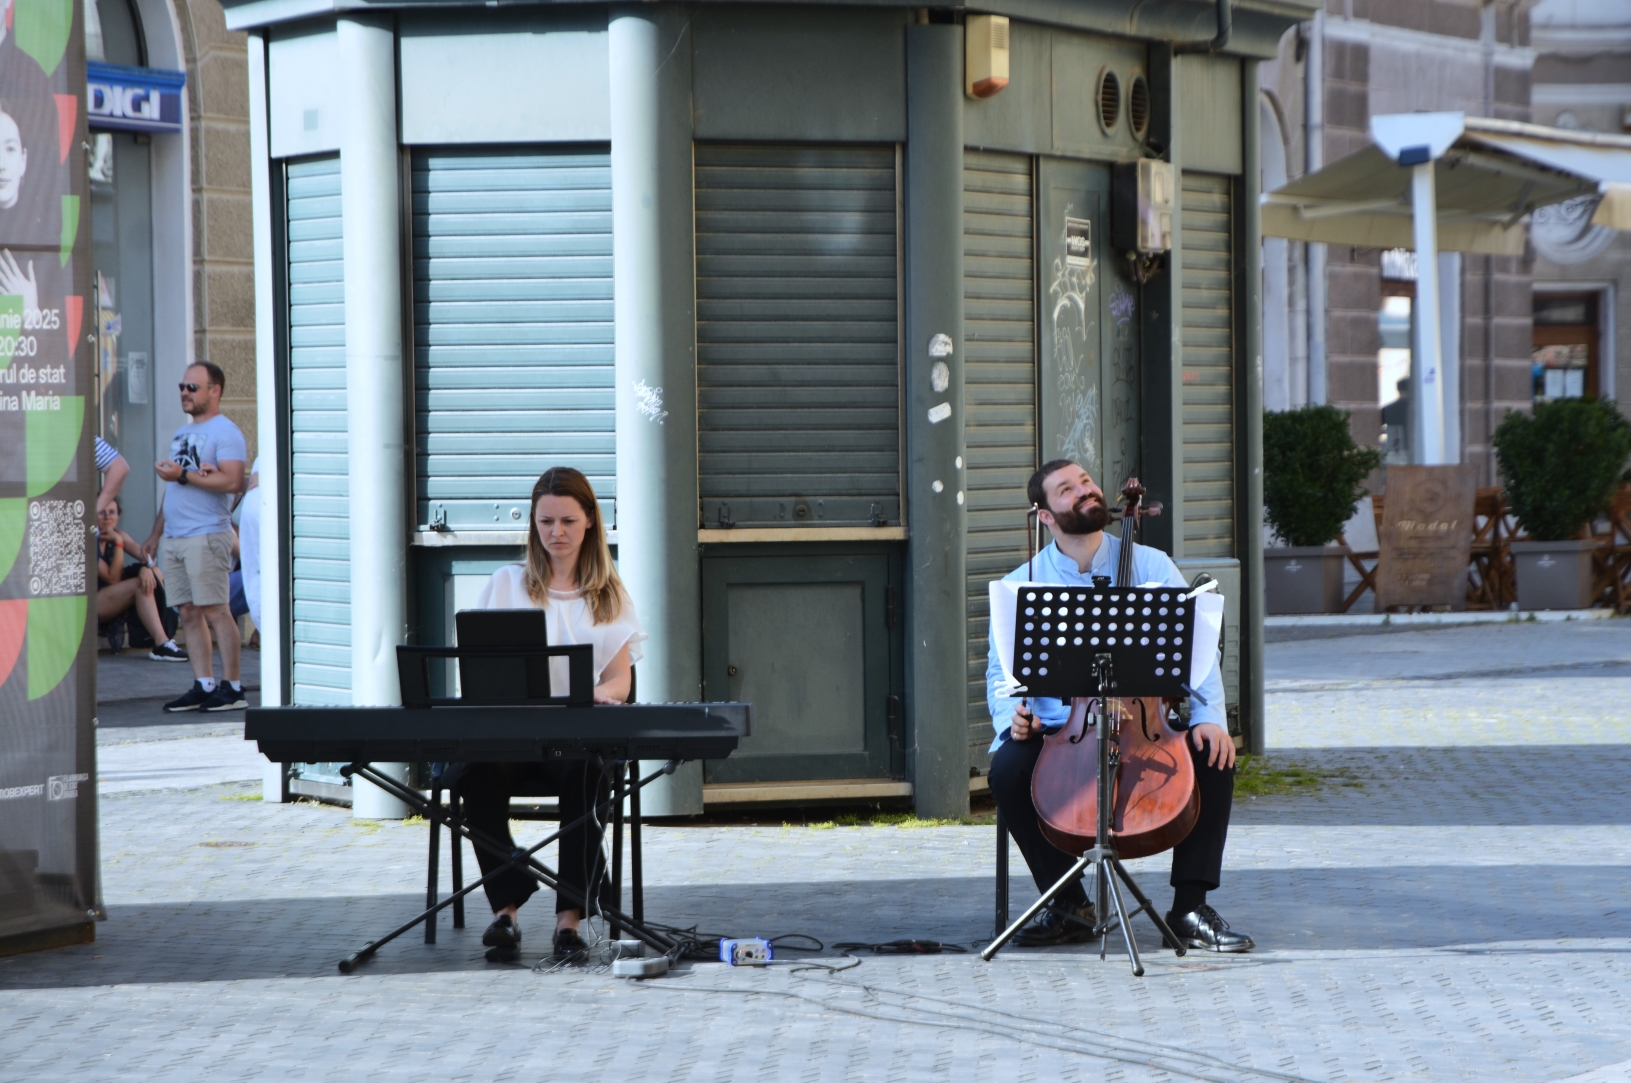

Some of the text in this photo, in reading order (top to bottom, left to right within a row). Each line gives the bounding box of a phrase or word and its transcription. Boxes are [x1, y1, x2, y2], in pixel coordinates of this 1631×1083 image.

[88, 83, 161, 121] DIGI
[23, 309, 60, 330] 2025
[0, 335, 37, 357] 20:30
[19, 363, 36, 384] de
[38, 364, 66, 384] stat
[22, 390, 61, 411] Maria
